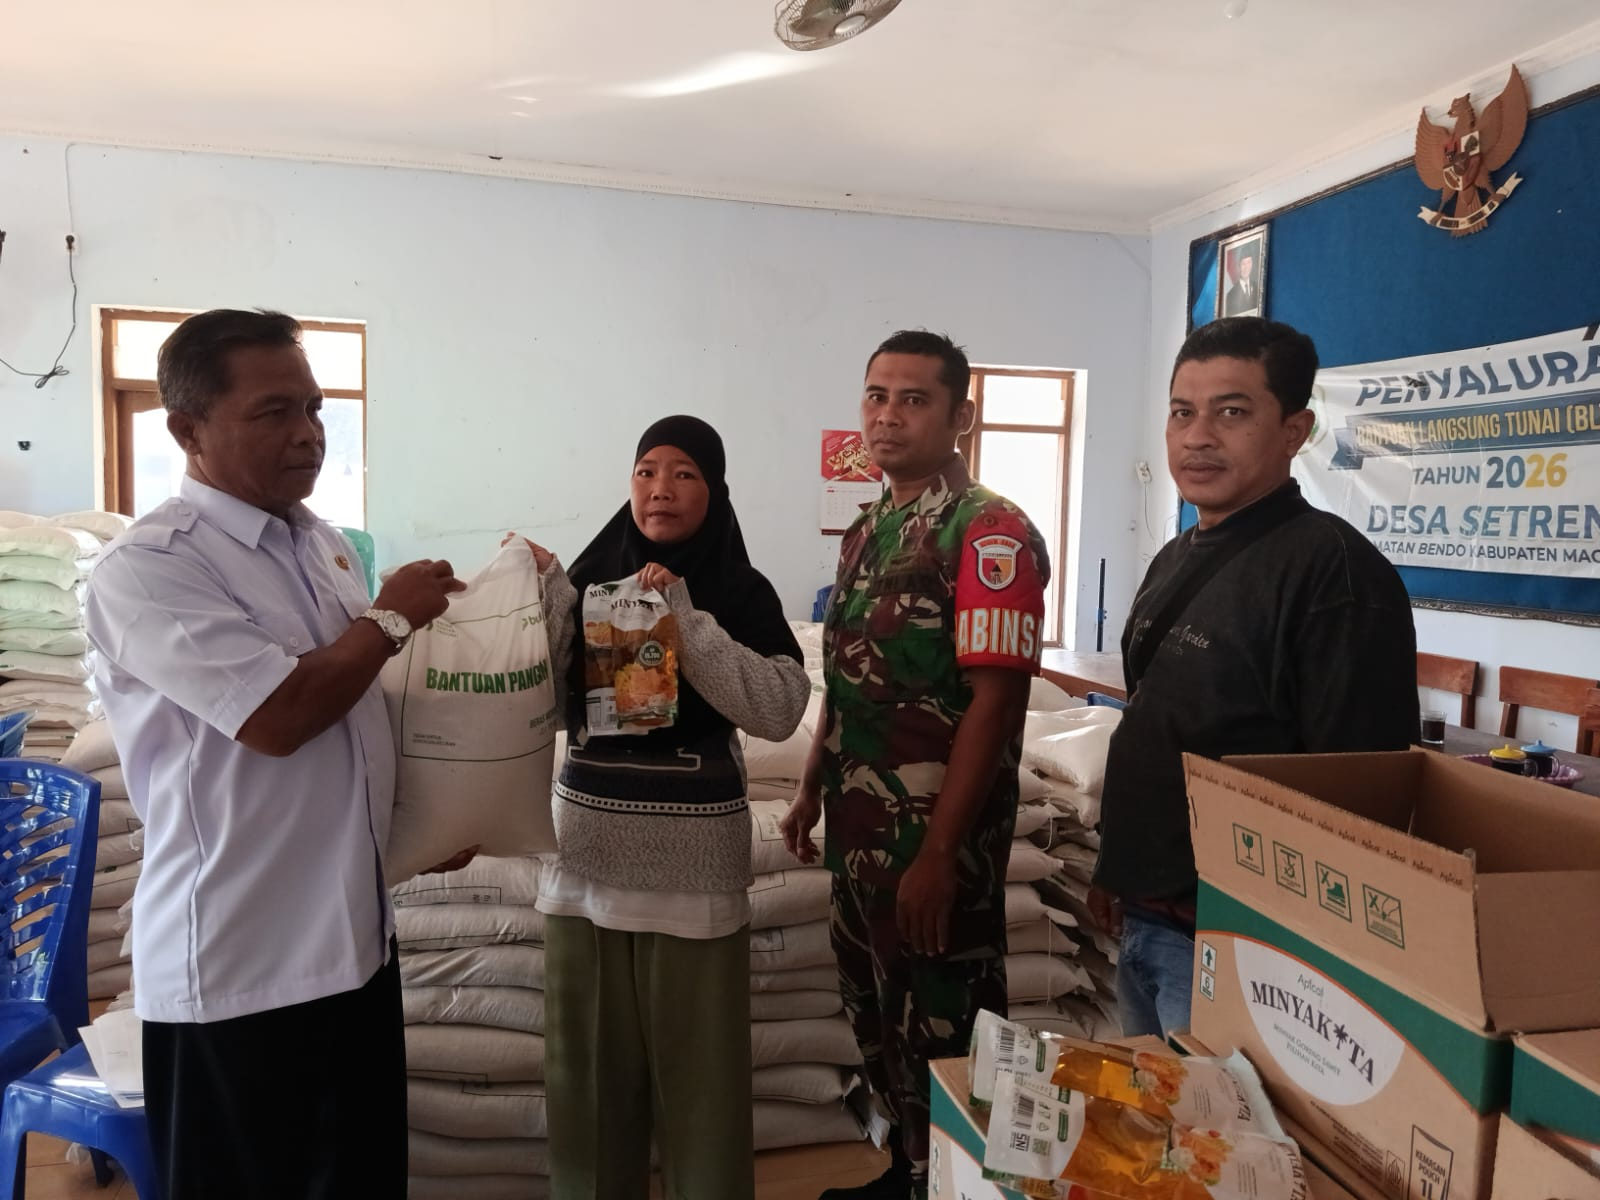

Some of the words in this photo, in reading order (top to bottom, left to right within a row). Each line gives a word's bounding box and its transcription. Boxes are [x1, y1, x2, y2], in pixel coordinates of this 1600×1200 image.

[1418, 413, 1501, 443] LANGSUNG
[1504, 407, 1560, 437] TUNAI
[1566, 404, 1600, 433] (BL
[1413, 465, 1480, 485] TAHUN
[1486, 453, 1568, 488] 2026
[1366, 504, 1449, 535] DESA
[1418, 543, 1466, 556] BENDO
[1469, 545, 1557, 562] KABUPATEN
[426, 667, 506, 694] BANTUAN
[1297, 973, 1324, 997] Apical
[1415, 1149, 1446, 1177] KEMASAN
[1418, 1162, 1440, 1184] POUCH
